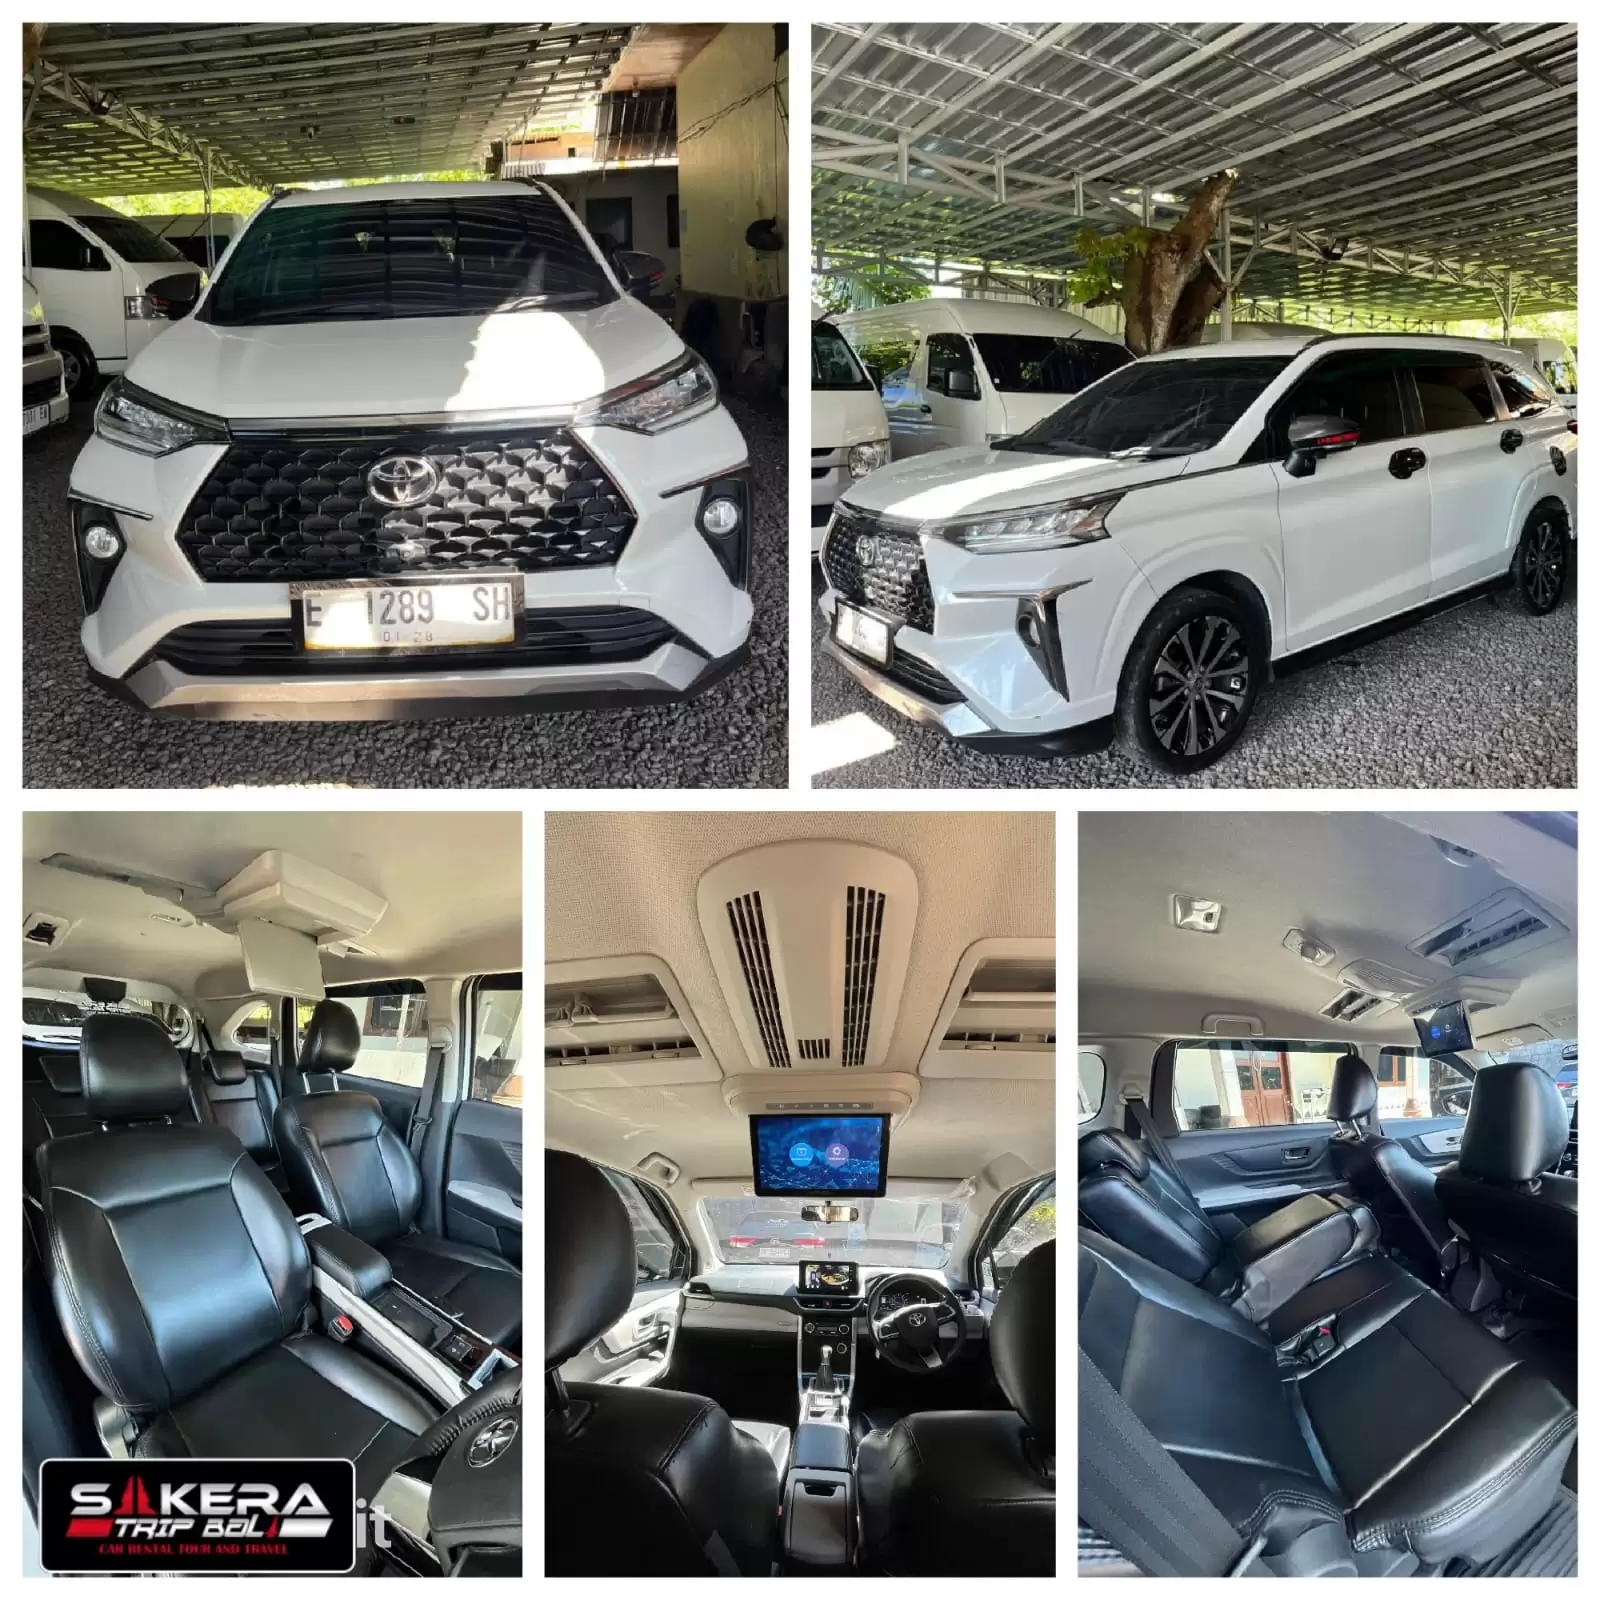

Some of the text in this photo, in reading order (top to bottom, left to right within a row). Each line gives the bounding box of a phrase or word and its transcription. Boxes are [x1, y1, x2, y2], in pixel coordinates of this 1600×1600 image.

[306, 586, 510, 627] E 1289 SH
